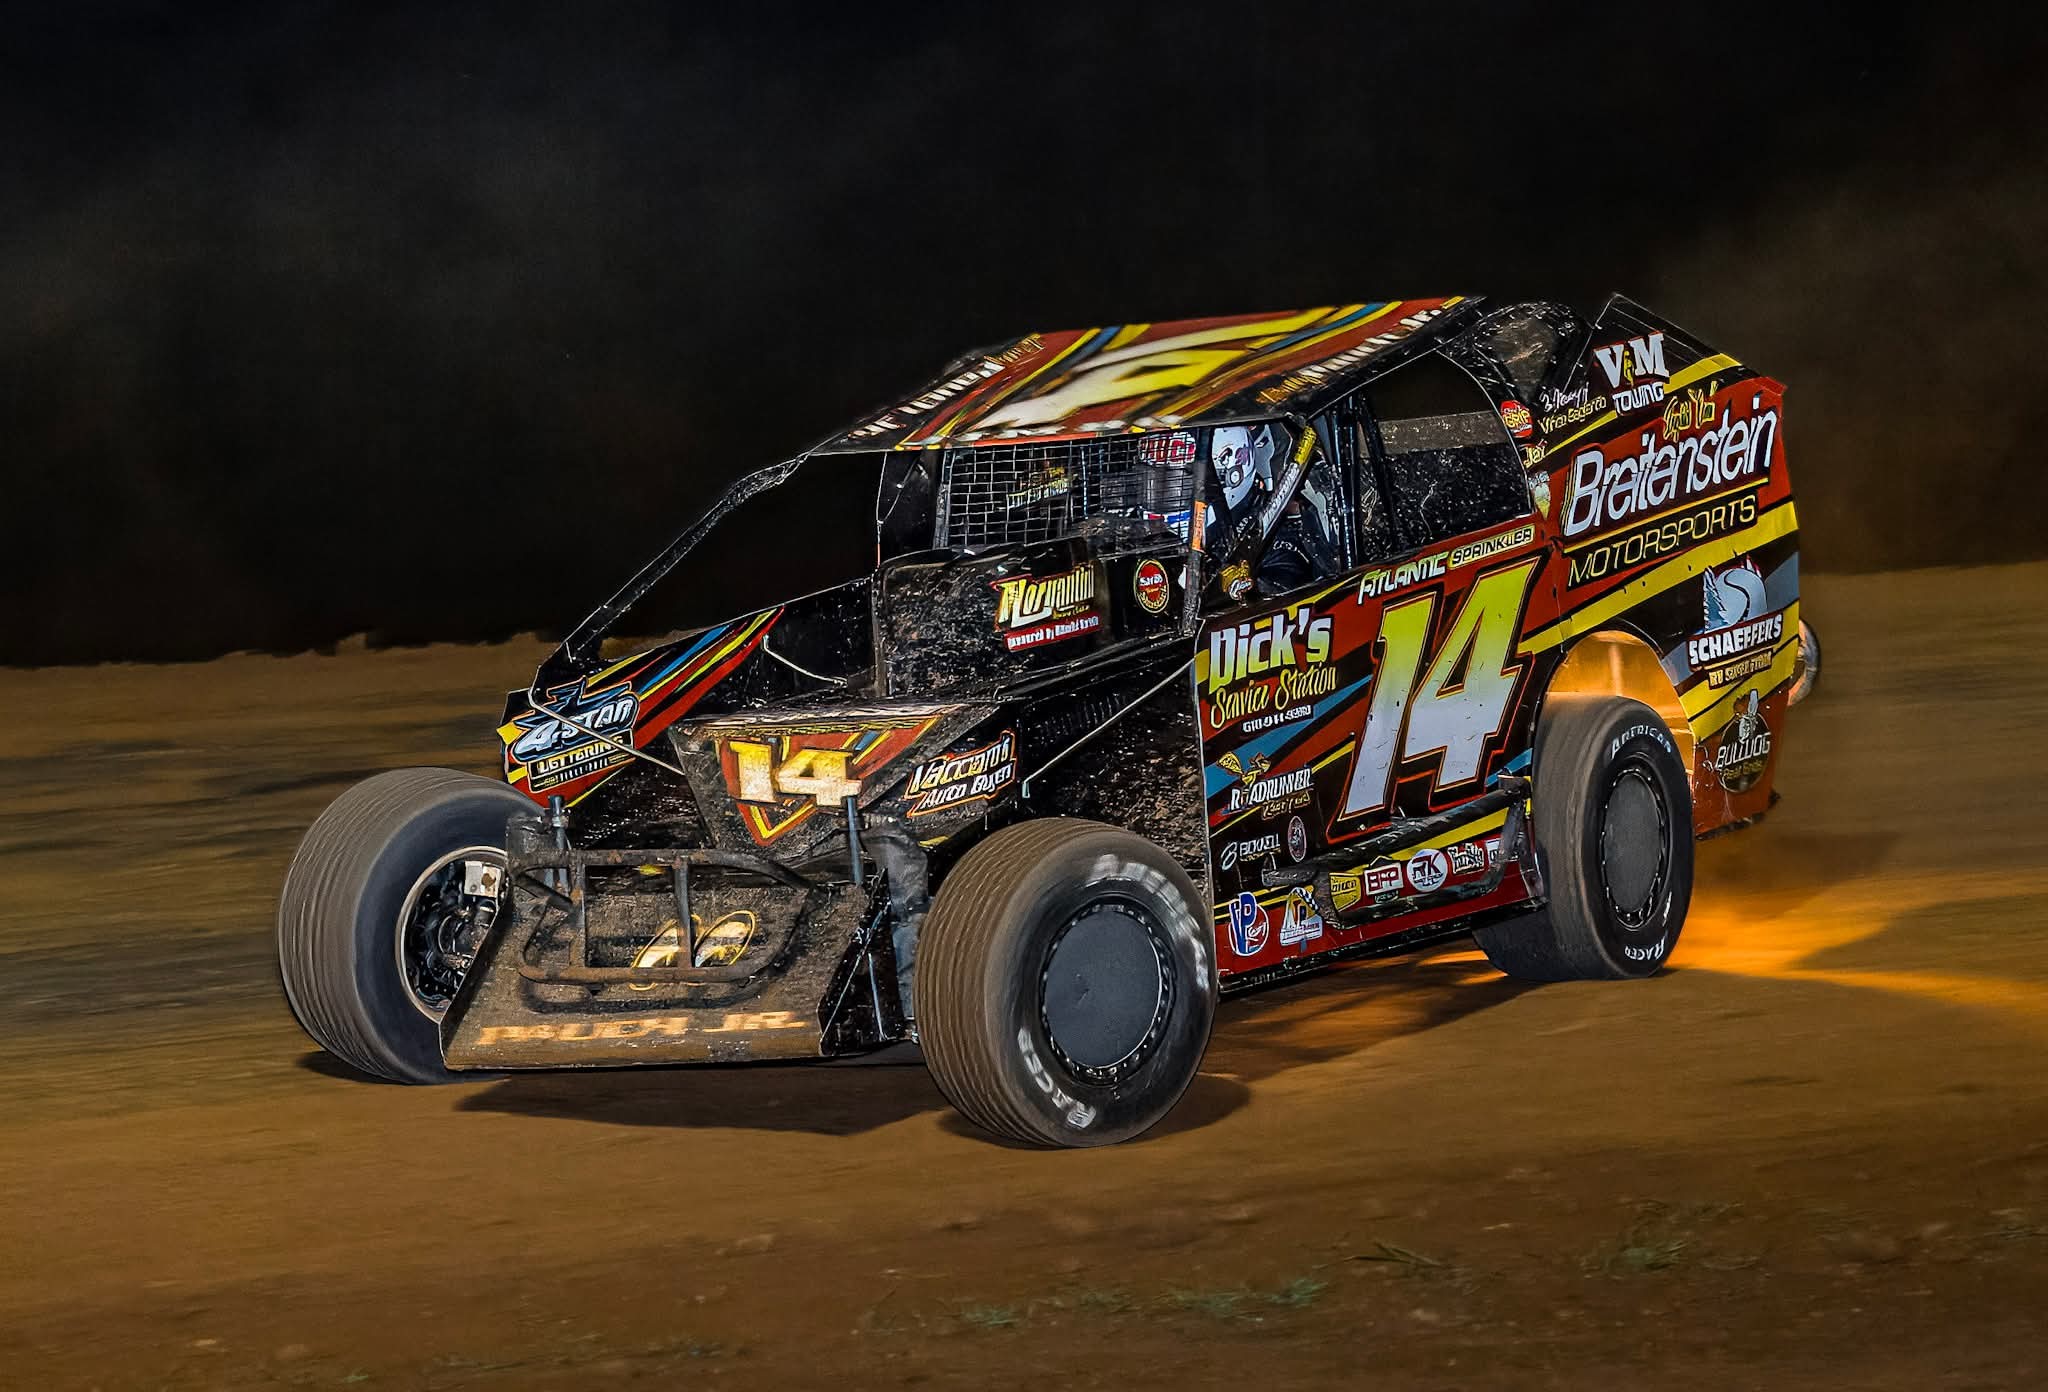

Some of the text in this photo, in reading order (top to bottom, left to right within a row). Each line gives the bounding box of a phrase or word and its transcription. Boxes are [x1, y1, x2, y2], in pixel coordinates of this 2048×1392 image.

[1612, 381, 1665, 414] TOWING
[1565, 393, 1777, 536] Breitenstein
[1357, 526, 1534, 605] ATLANTIC SPRINKLER
[1568, 494, 1756, 587] MOTORSPORTS
[1209, 607, 1332, 694] Dick's
[1336, 556, 1541, 820] 14
[729, 739, 862, 806] 14
[1715, 732, 1771, 768] BULLDOG
